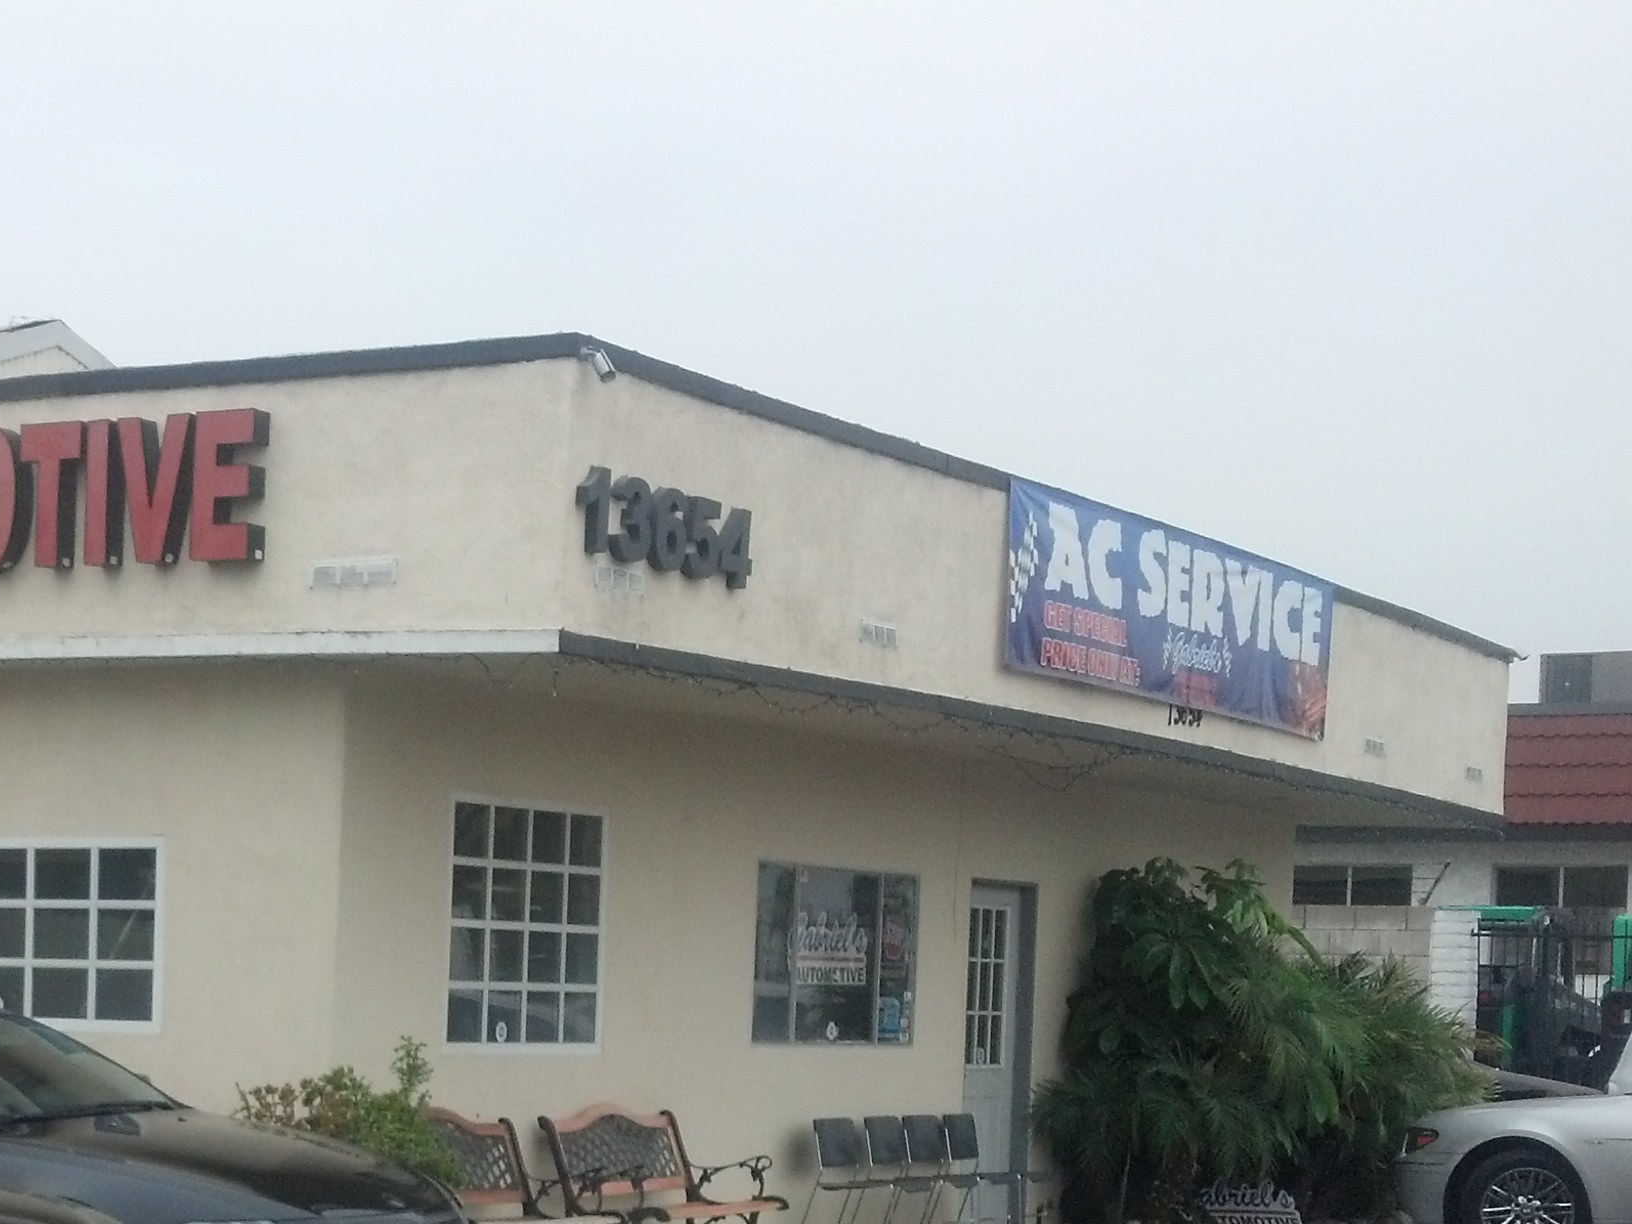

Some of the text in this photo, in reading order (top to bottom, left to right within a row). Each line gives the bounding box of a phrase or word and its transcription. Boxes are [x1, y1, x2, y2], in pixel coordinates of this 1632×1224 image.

[575, 465, 753, 589] 13654
[1044, 501, 1323, 666] AC SERVICE
[1040, 637, 1087, 673] PRICE
